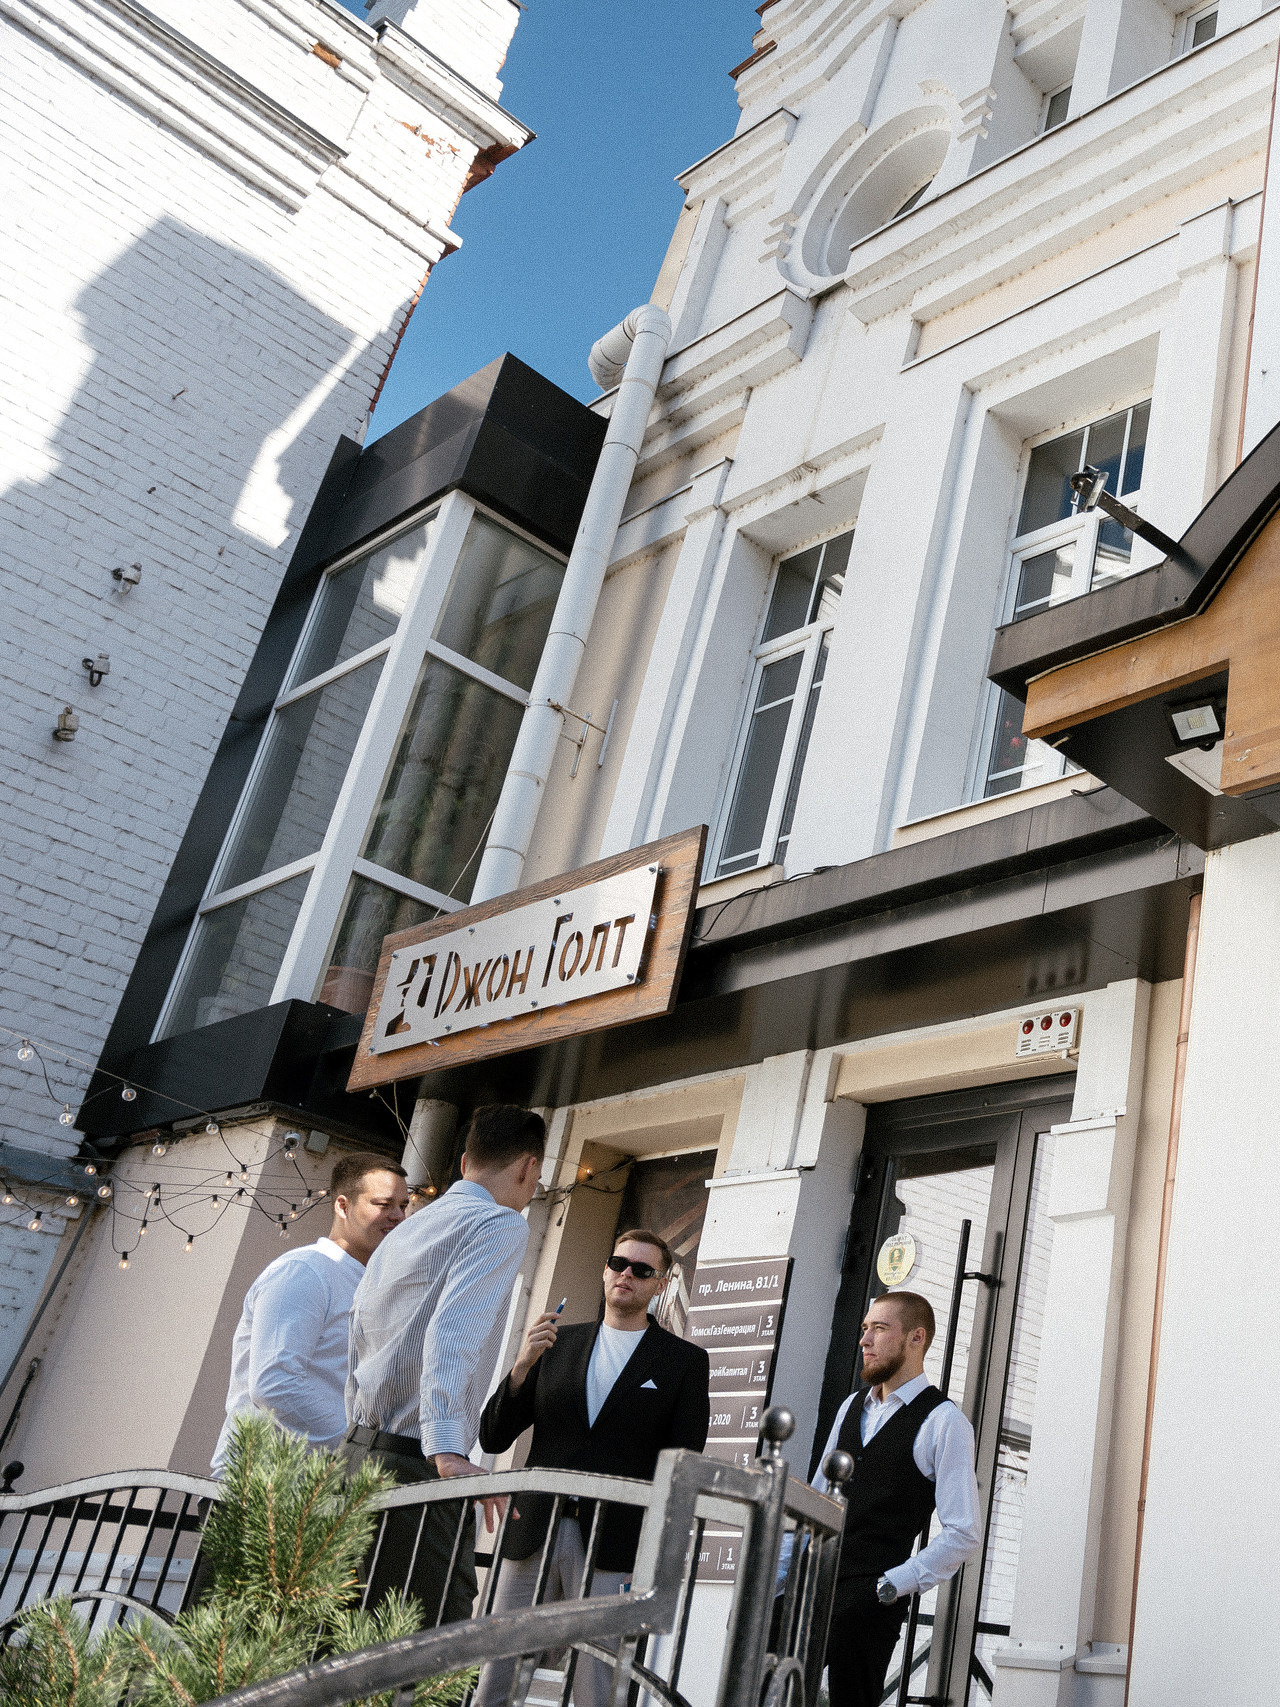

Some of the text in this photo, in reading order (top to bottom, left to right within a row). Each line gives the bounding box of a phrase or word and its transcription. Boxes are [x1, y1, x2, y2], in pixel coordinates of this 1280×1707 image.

[698, 1274, 779, 1297] пр. Ленина, 81/1
[690, 1315, 774, 1337] ТомскГазГенерация 3
[761, 1329, 775, 1337] ЭТАЖ
[757, 1360, 766, 1374] 3
[752, 1375, 767, 1383] ЭТАЖ
[712, 1413, 732, 1426] 2020
[749, 1406, 758, 1420] 3
[726, 1547, 734, 1562] 1
